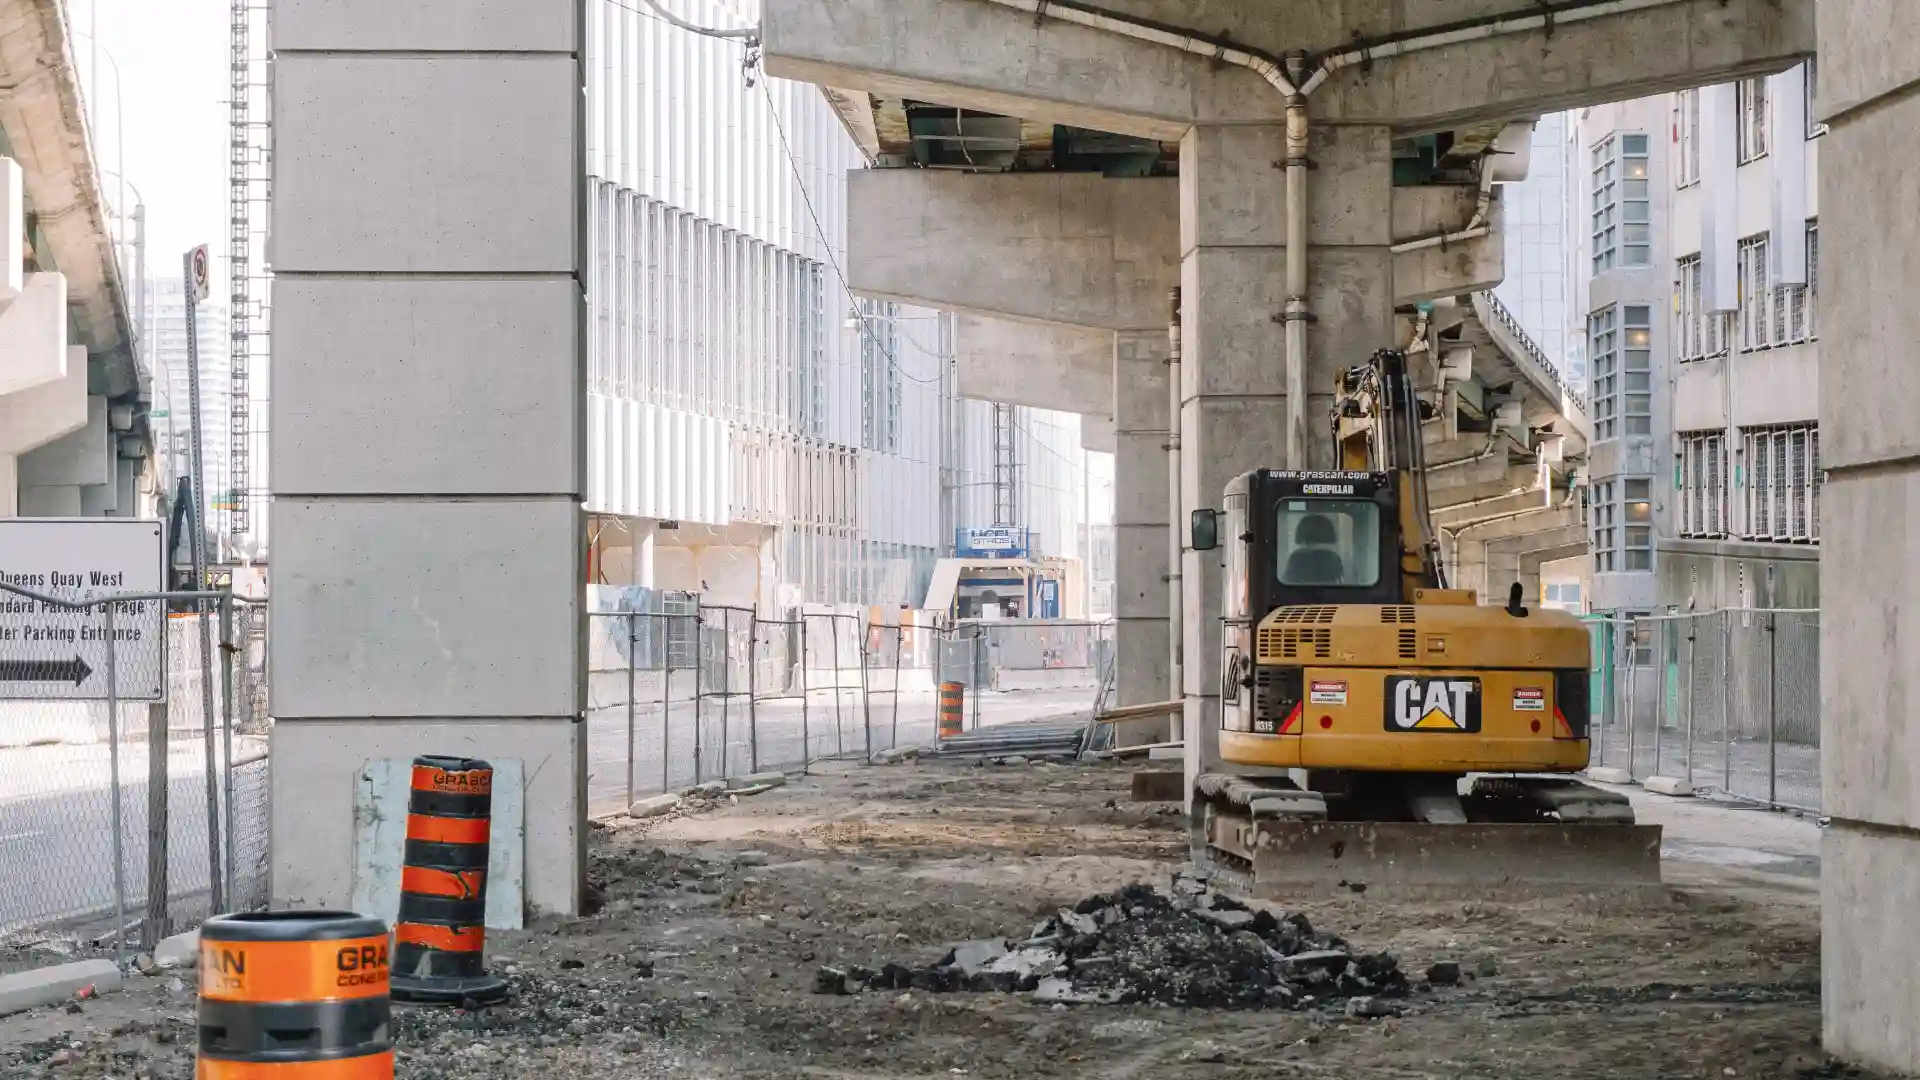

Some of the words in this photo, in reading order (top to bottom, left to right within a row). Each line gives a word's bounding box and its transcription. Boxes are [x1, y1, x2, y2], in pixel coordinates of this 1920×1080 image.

[1269, 470, 1370, 480] www.grascan.com
[1302, 484, 1355, 495] CATERPILLAR
[51, 570, 83, 588] Quay
[89, 570, 122, 586] West
[99, 600, 145, 616] Grage
[24, 625, 75, 643] Parking
[1395, 680, 1473, 728] CAT
